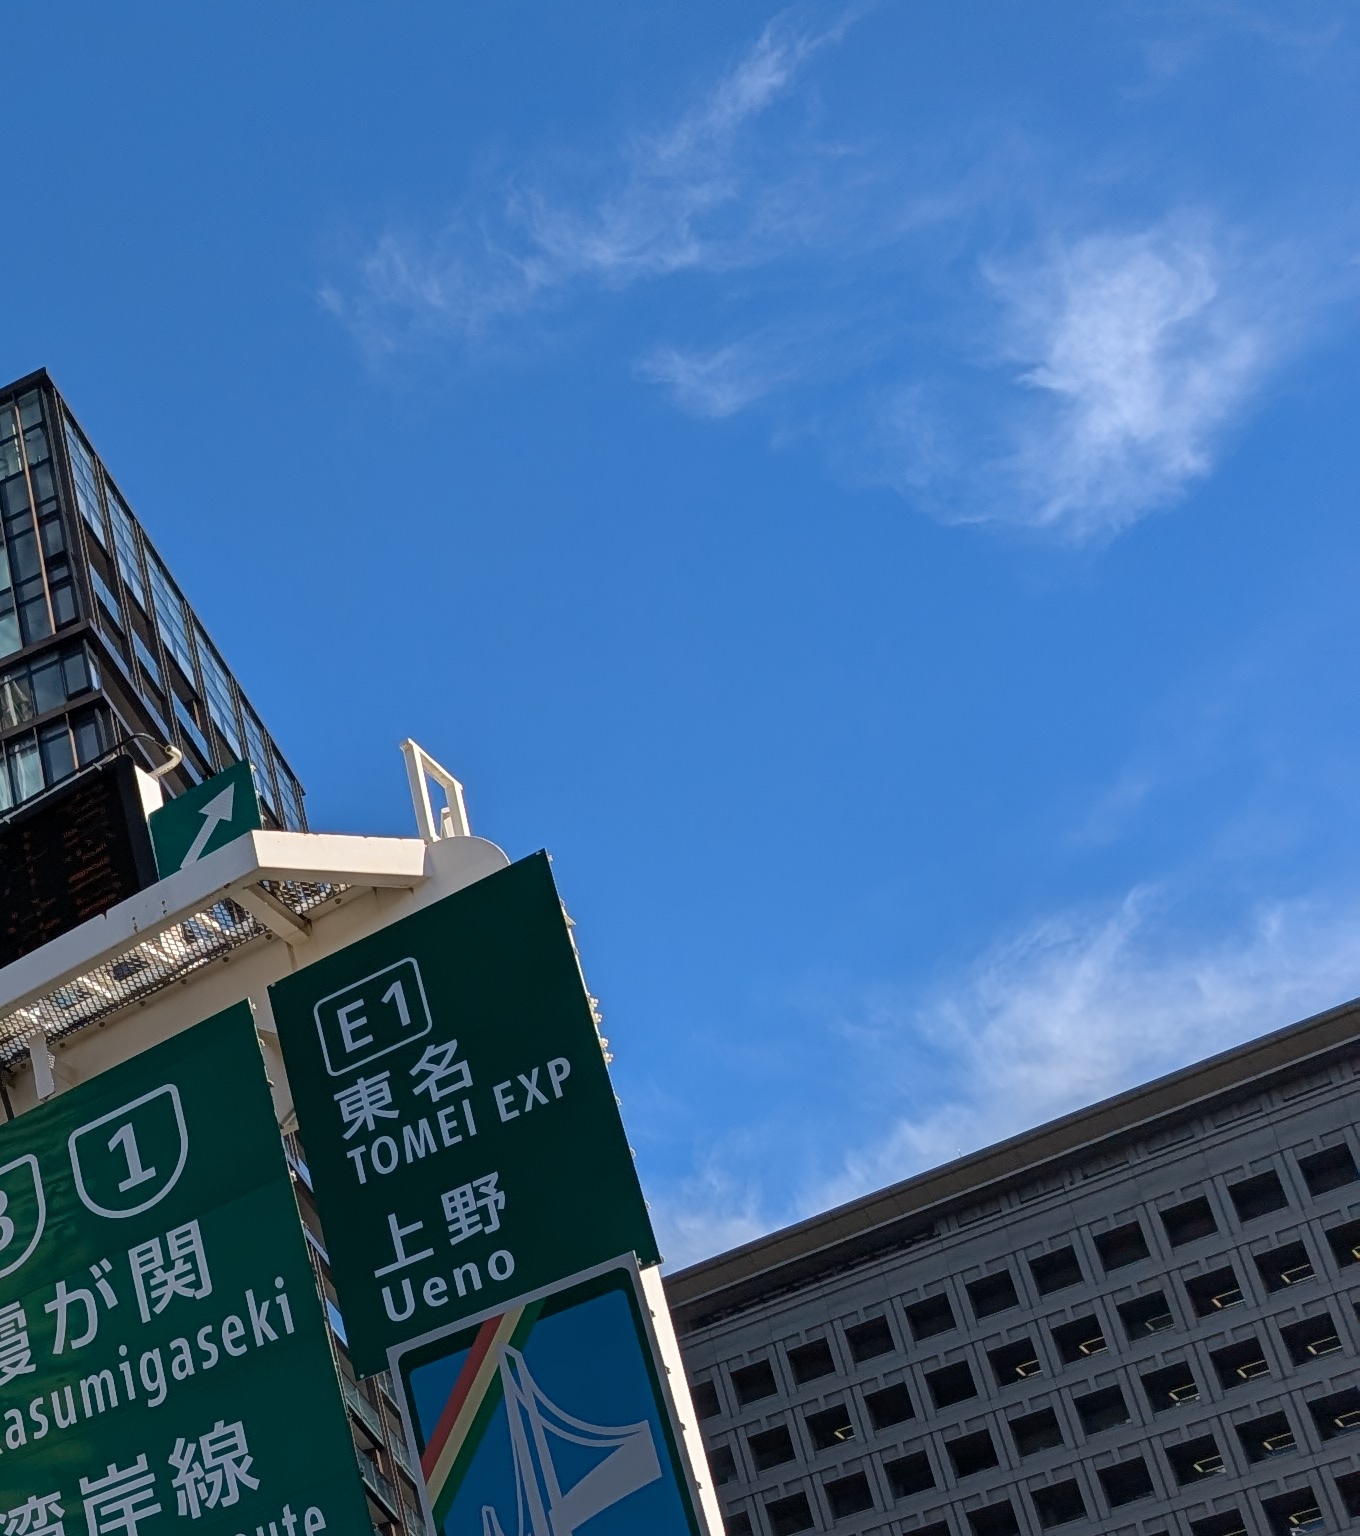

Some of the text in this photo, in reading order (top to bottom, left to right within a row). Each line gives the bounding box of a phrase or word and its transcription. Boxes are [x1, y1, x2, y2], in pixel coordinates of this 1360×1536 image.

[333, 1038, 474, 1141] 東名
[346, 1057, 571, 1185] TOMEI EXP
[107, 1122, 157, 1193] 1
[374, 1171, 506, 1279] 上野
[381, 1249, 515, 1322] Ueno
